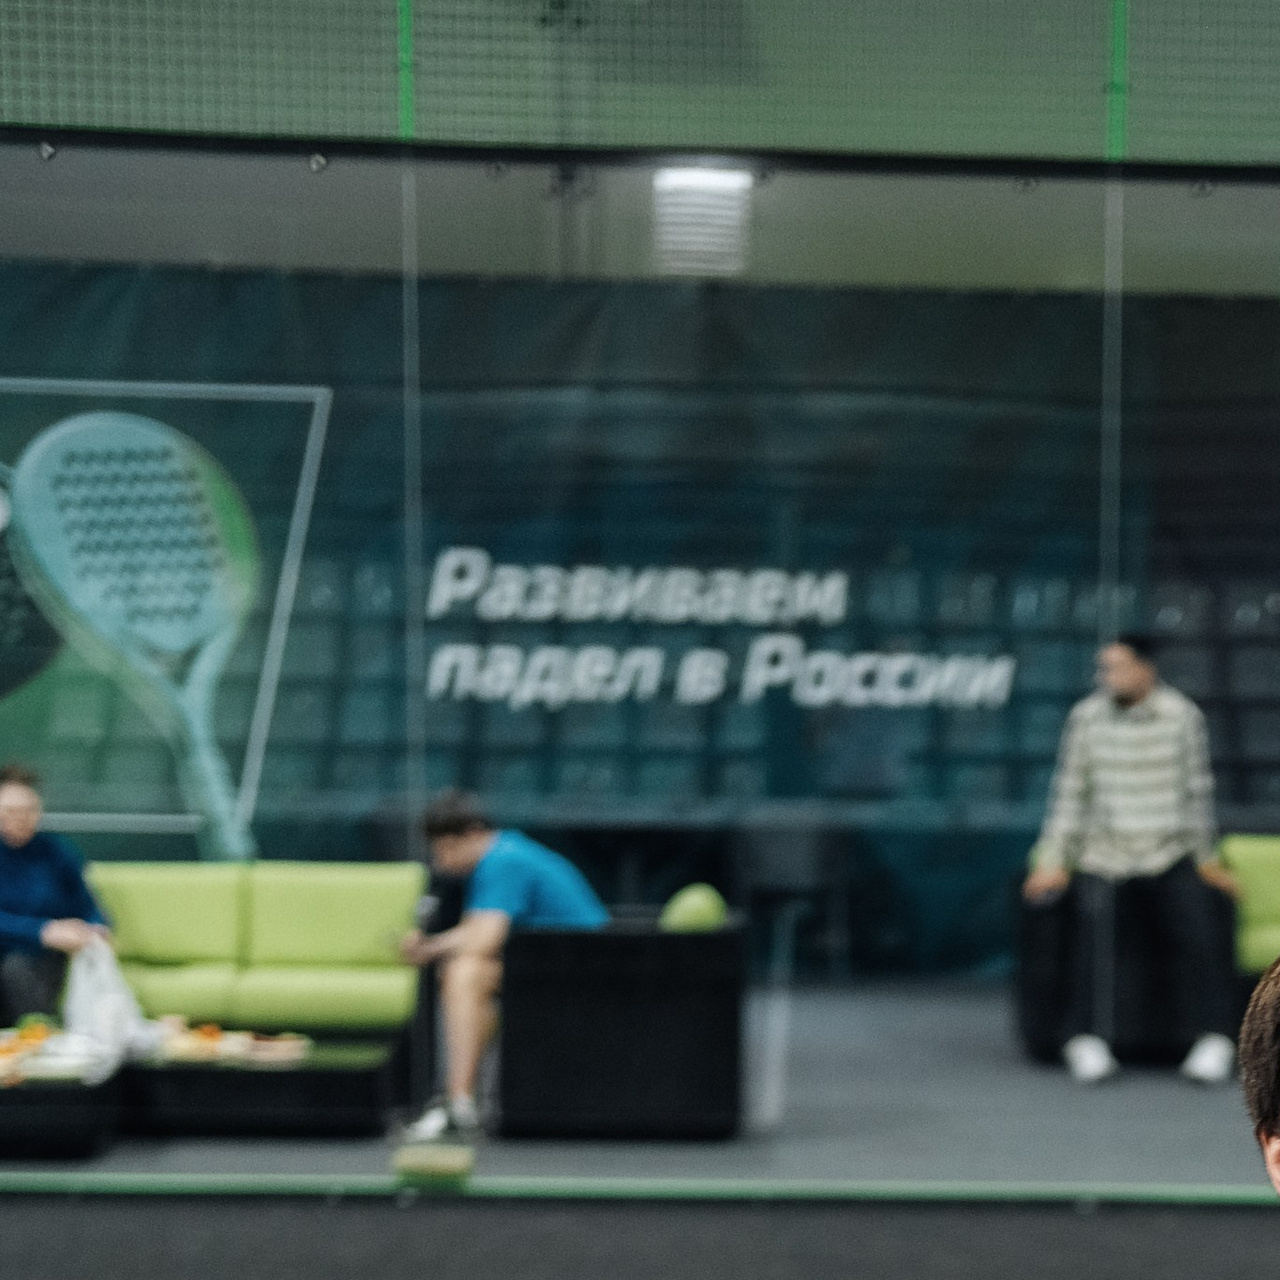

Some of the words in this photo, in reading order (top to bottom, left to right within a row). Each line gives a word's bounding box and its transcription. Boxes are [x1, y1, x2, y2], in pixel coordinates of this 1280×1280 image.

[427, 546, 850, 626] Развиваем
[427, 642, 664, 711] падел
[674, 646, 730, 705] в
[740, 632, 1017, 710] России
